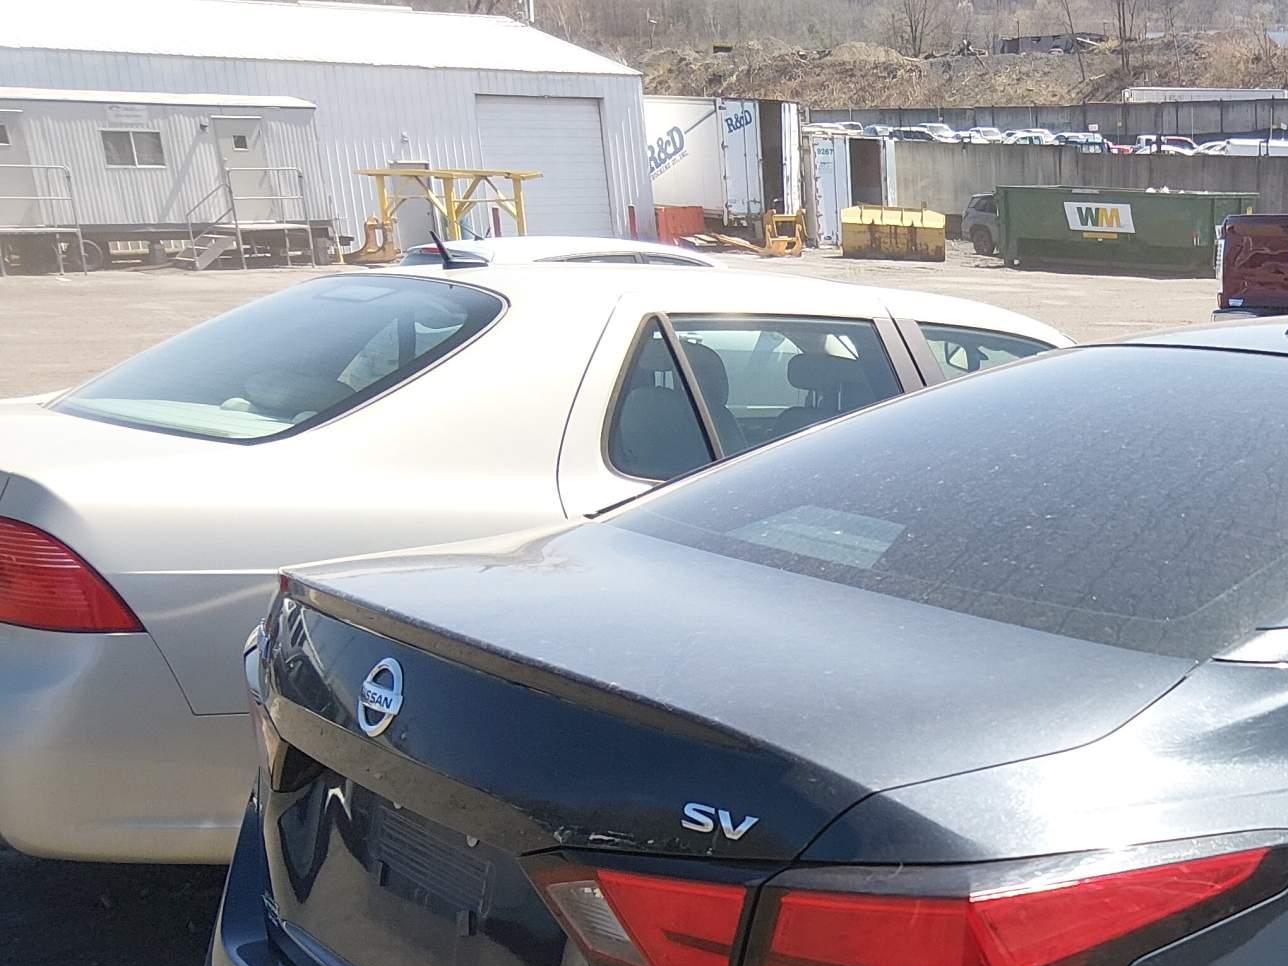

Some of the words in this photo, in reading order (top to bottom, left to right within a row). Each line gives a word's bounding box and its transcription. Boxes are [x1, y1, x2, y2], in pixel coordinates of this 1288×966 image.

[725, 109, 753, 134] R&D
[1076, 206, 1121, 227] WM
[681, 802, 760, 840] SV
